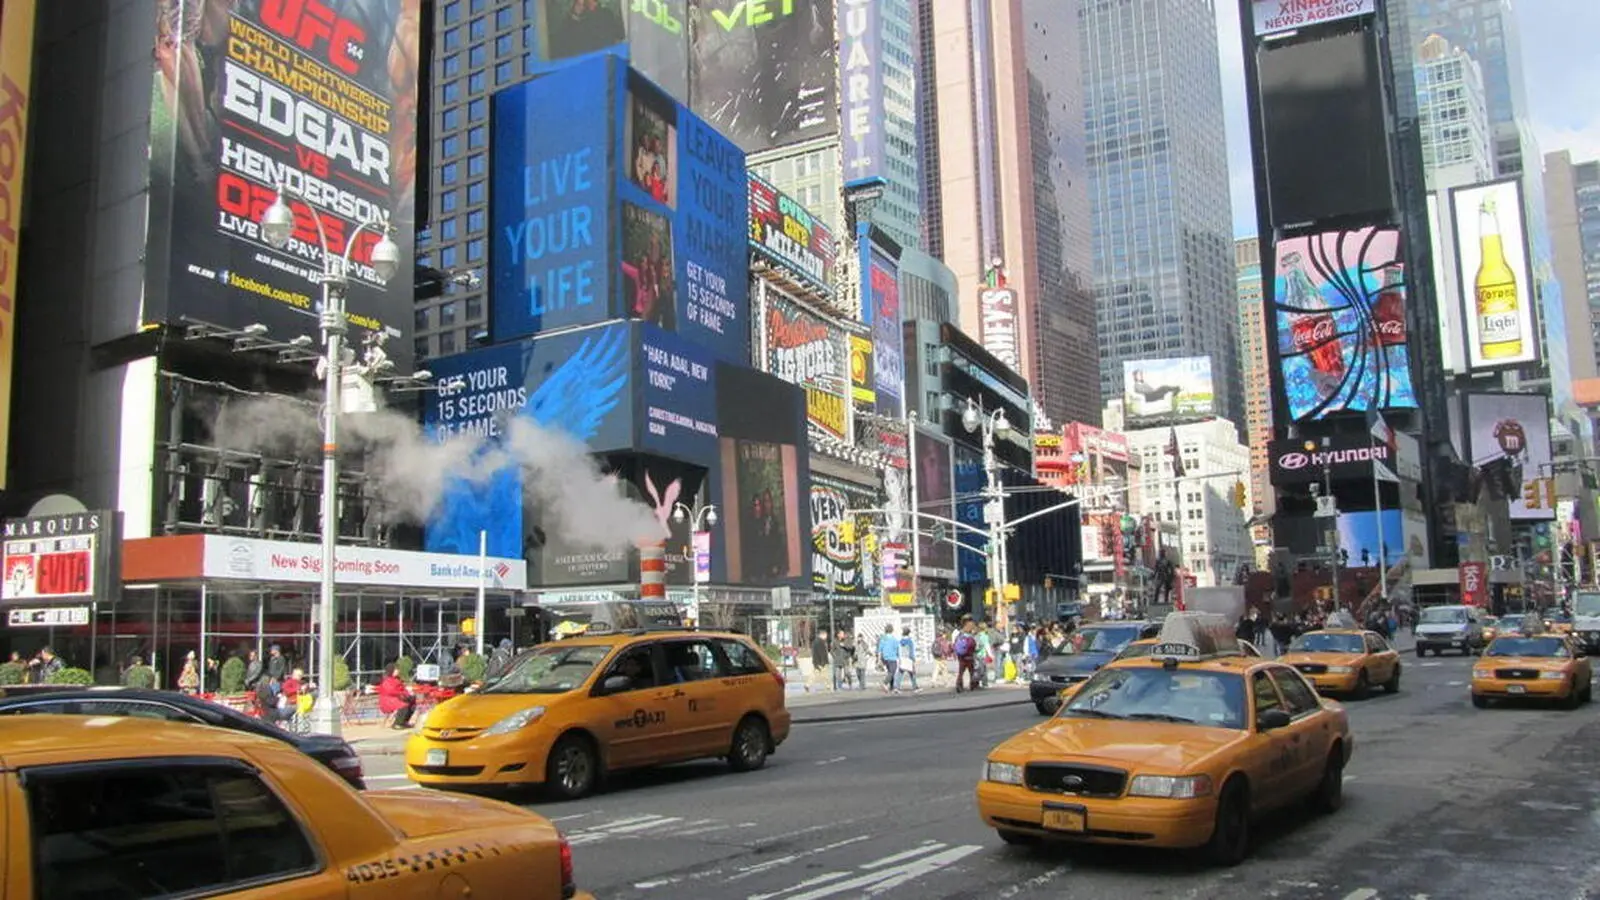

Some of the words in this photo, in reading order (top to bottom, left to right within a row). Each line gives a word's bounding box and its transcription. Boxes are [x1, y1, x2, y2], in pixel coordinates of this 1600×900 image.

[1265, 14, 1303, 29] NEWS
[1307, 2, 1363, 21] AGENCY
[1281, 0, 1344, 15] XINH
[260, 0, 366, 75] UFC
[227, 37, 391, 135] CHAMPIONSHIP
[229, 17, 290, 63] WORLD
[292, 52, 391, 117] LIGHTWEIGHT
[845, 0, 871, 137] UARE
[223, 60, 391, 186] EDGAR
[295, 144, 329, 178] VS
[685, 119, 737, 182] LEAVE
[221, 137, 391, 228] HENDERSON
[523, 146, 591, 208] LIVE
[691, 168, 735, 225] YOUR
[219, 212, 258, 238] LIVE
[504, 204, 593, 265] YOUR
[530, 260, 594, 317] LIFE
[686, 259, 703, 283] GET
[438, 373, 464, 397] GET
[468, 366, 508, 392] YOUR
[438, 399, 455, 420] 15
[458, 387, 528, 418] SECONDS
[1311, 446, 1388, 466] HYUNDAI
[4, 515, 99, 537] MARQUIS
[271, 553, 297, 569] New
[301, 555, 323, 572] Sig
[332, 556, 372, 575] Coming
[373, 558, 400, 574] Soon
[430, 563, 451, 577] Bank
[453, 565, 462, 577] of
[462, 565, 493, 578] Ameca
